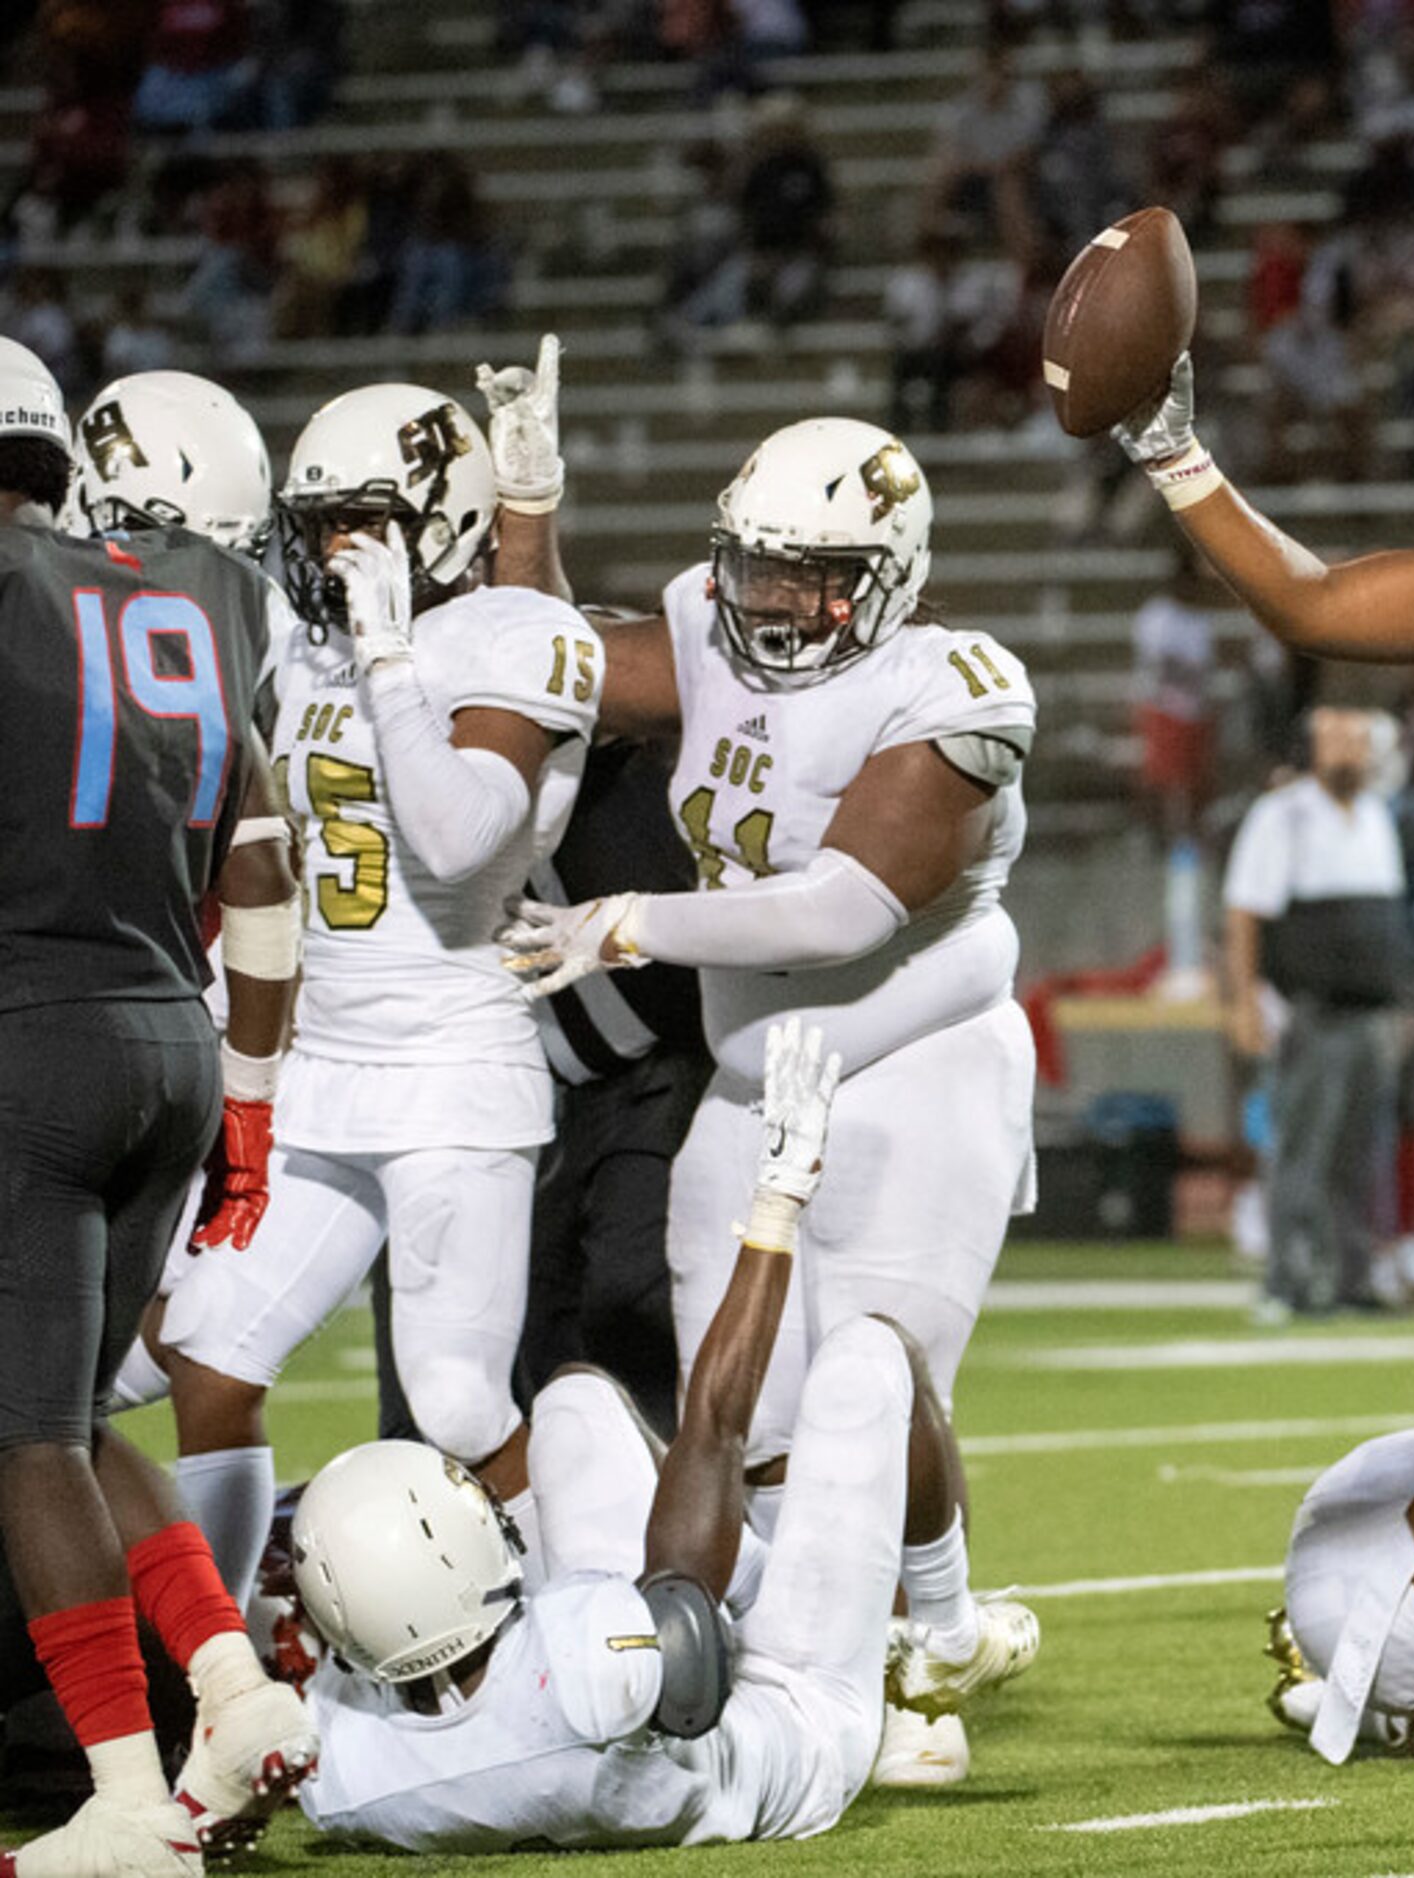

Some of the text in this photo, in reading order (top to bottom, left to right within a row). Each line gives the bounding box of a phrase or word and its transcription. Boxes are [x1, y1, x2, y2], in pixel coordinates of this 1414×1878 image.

[546, 634, 595, 703] 15
[947, 643, 1010, 699] 11
[69, 586, 230, 829] 19
[296, 702, 354, 744] SOC
[709, 737, 773, 794] SOC
[275, 751, 389, 931] 5
[606, 1634, 661, 1652] 1
